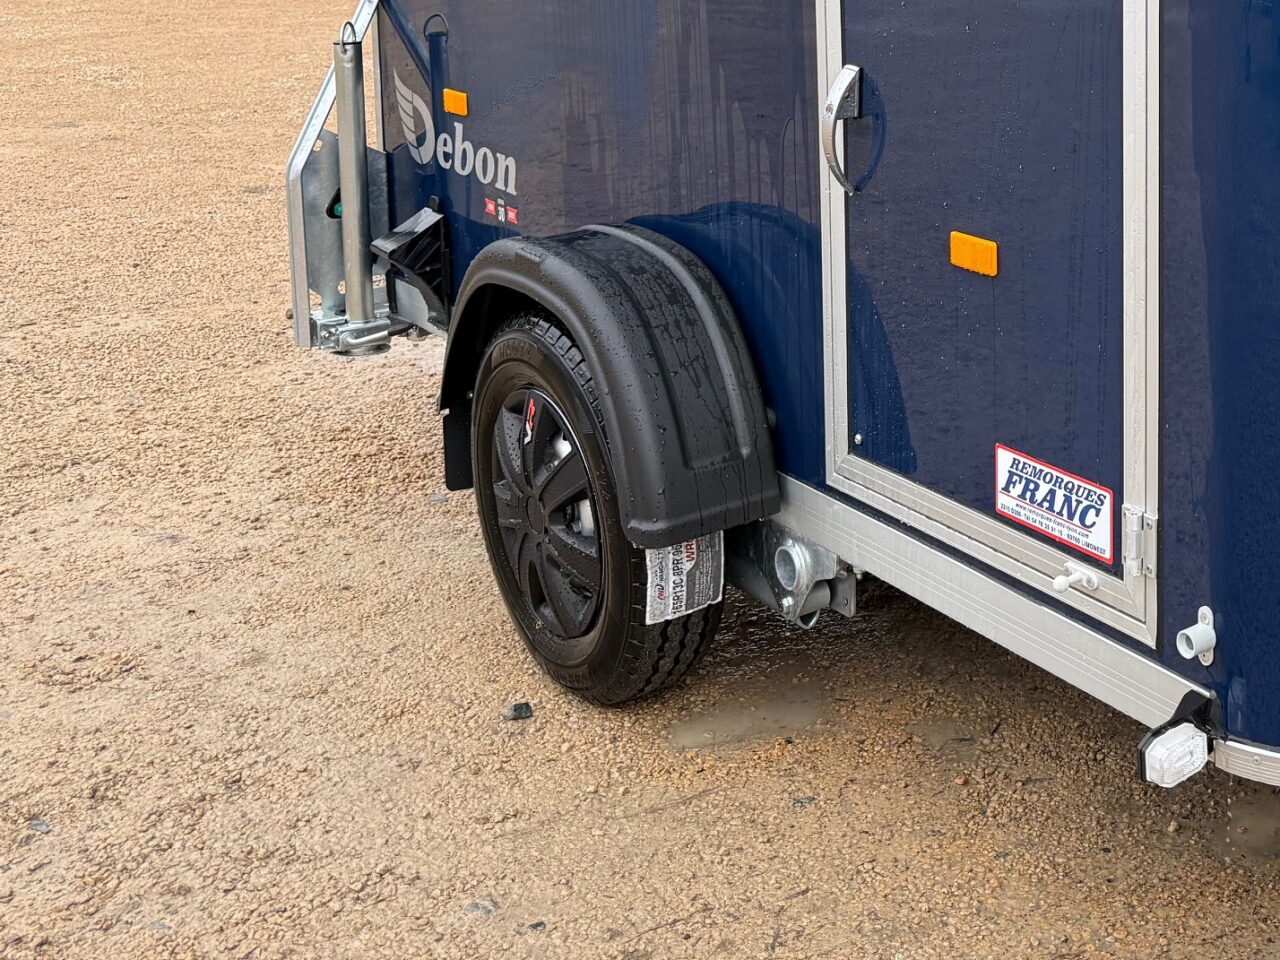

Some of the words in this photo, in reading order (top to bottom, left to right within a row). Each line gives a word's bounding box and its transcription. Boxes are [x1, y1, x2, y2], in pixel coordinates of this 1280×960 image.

[393, 68, 517, 196] Debon
[1001, 469, 1102, 530] FRANC
[1009, 457, 1107, 507] REMORQUES
